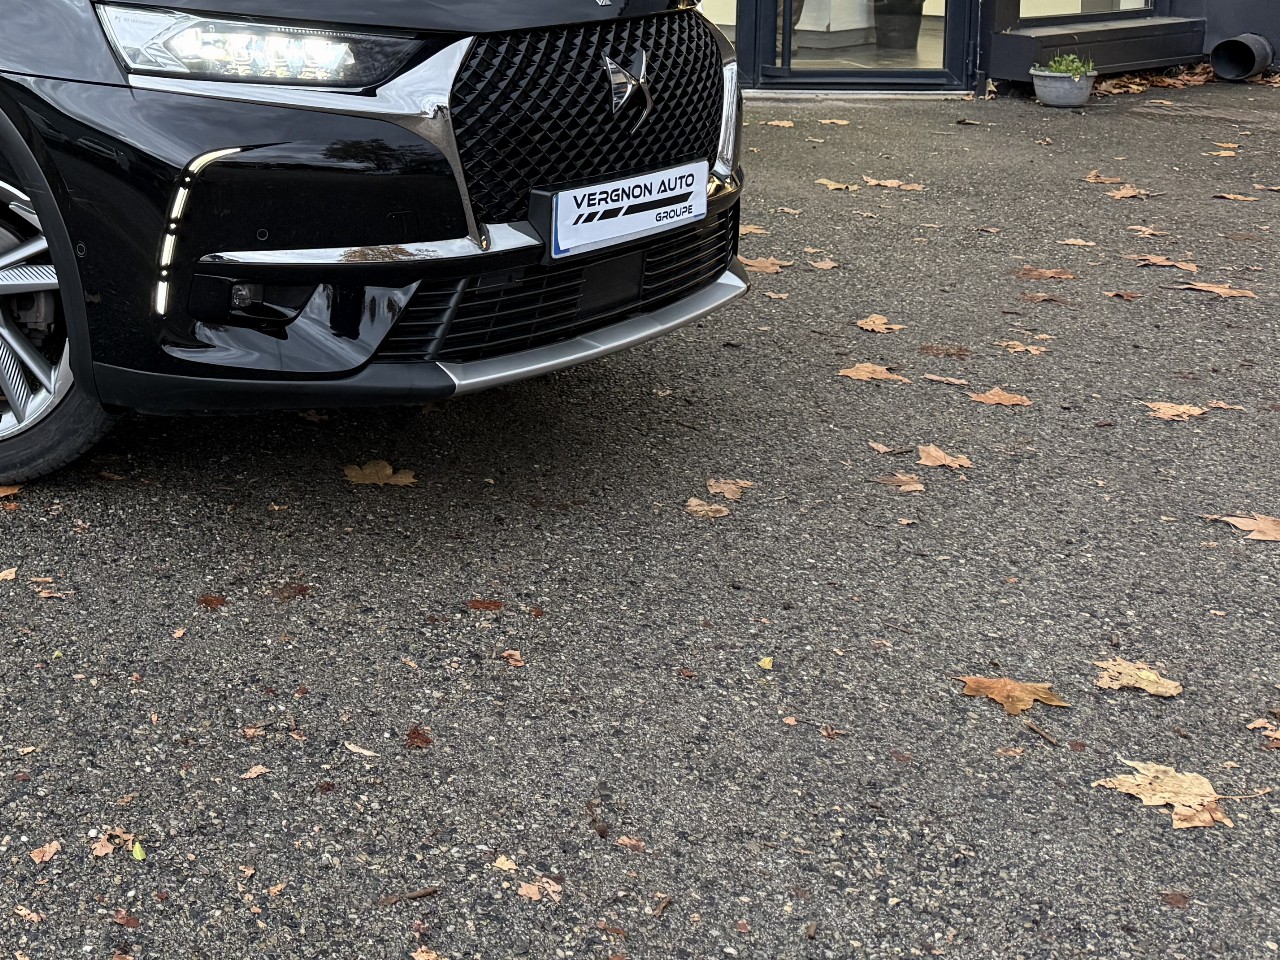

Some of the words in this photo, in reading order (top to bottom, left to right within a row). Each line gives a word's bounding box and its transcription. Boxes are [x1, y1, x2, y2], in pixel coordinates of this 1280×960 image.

[573, 181, 653, 209] VERGNON
[656, 173, 695, 194] AUTO
[655, 204, 693, 223] GROUPE
